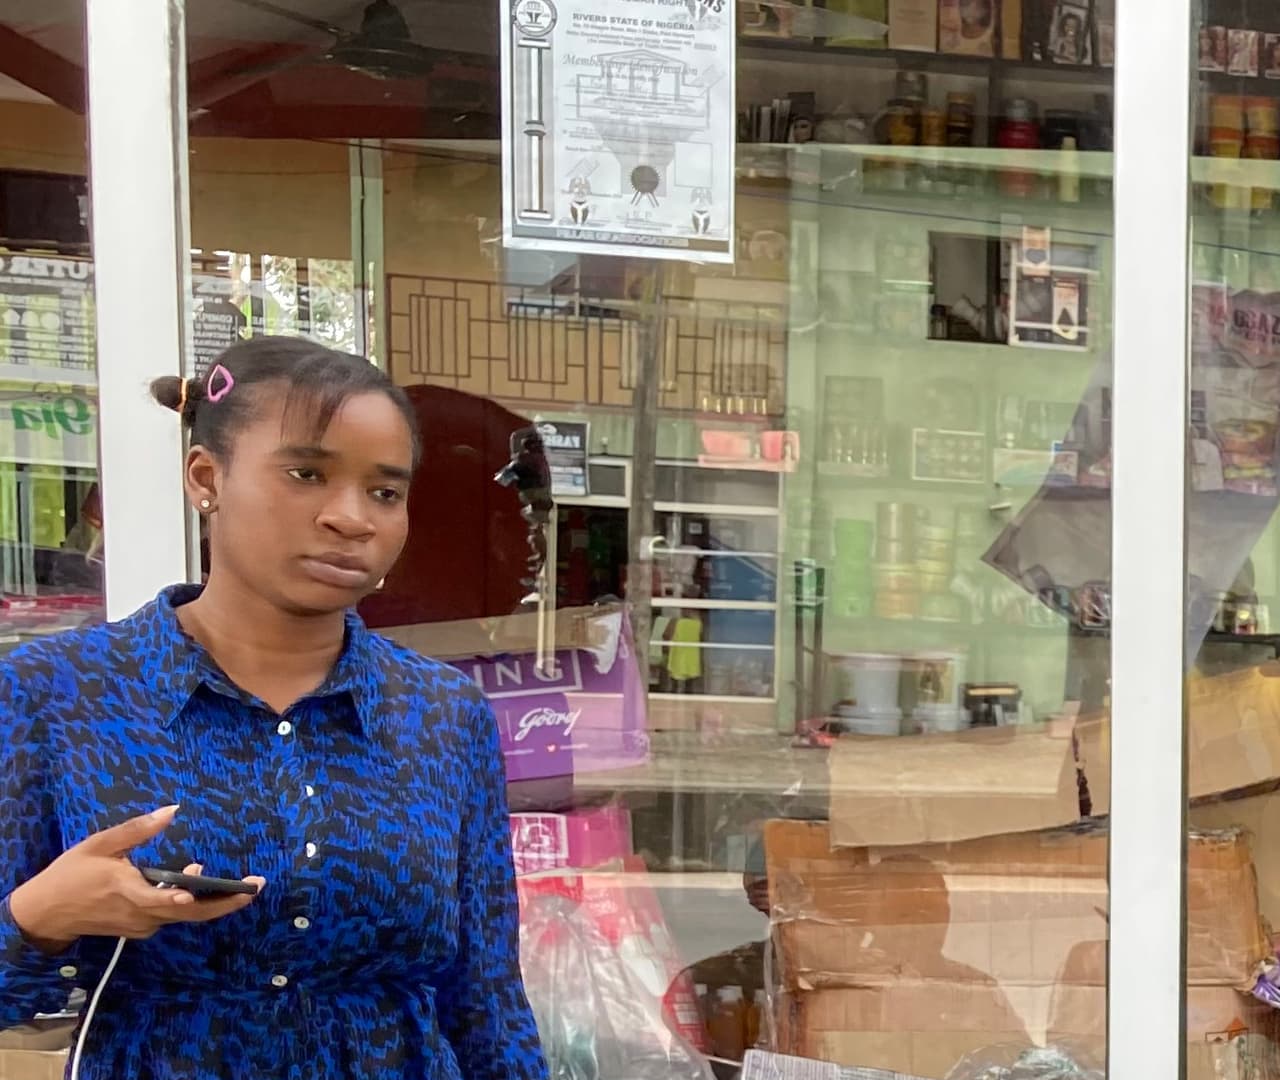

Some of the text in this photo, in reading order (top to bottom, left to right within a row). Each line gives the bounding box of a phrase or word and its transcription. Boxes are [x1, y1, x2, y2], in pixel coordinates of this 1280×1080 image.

[572, 13, 607, 23] RIVERS
[609, 15, 638, 26] STATE
[655, 22, 695, 31] NIGERIA
